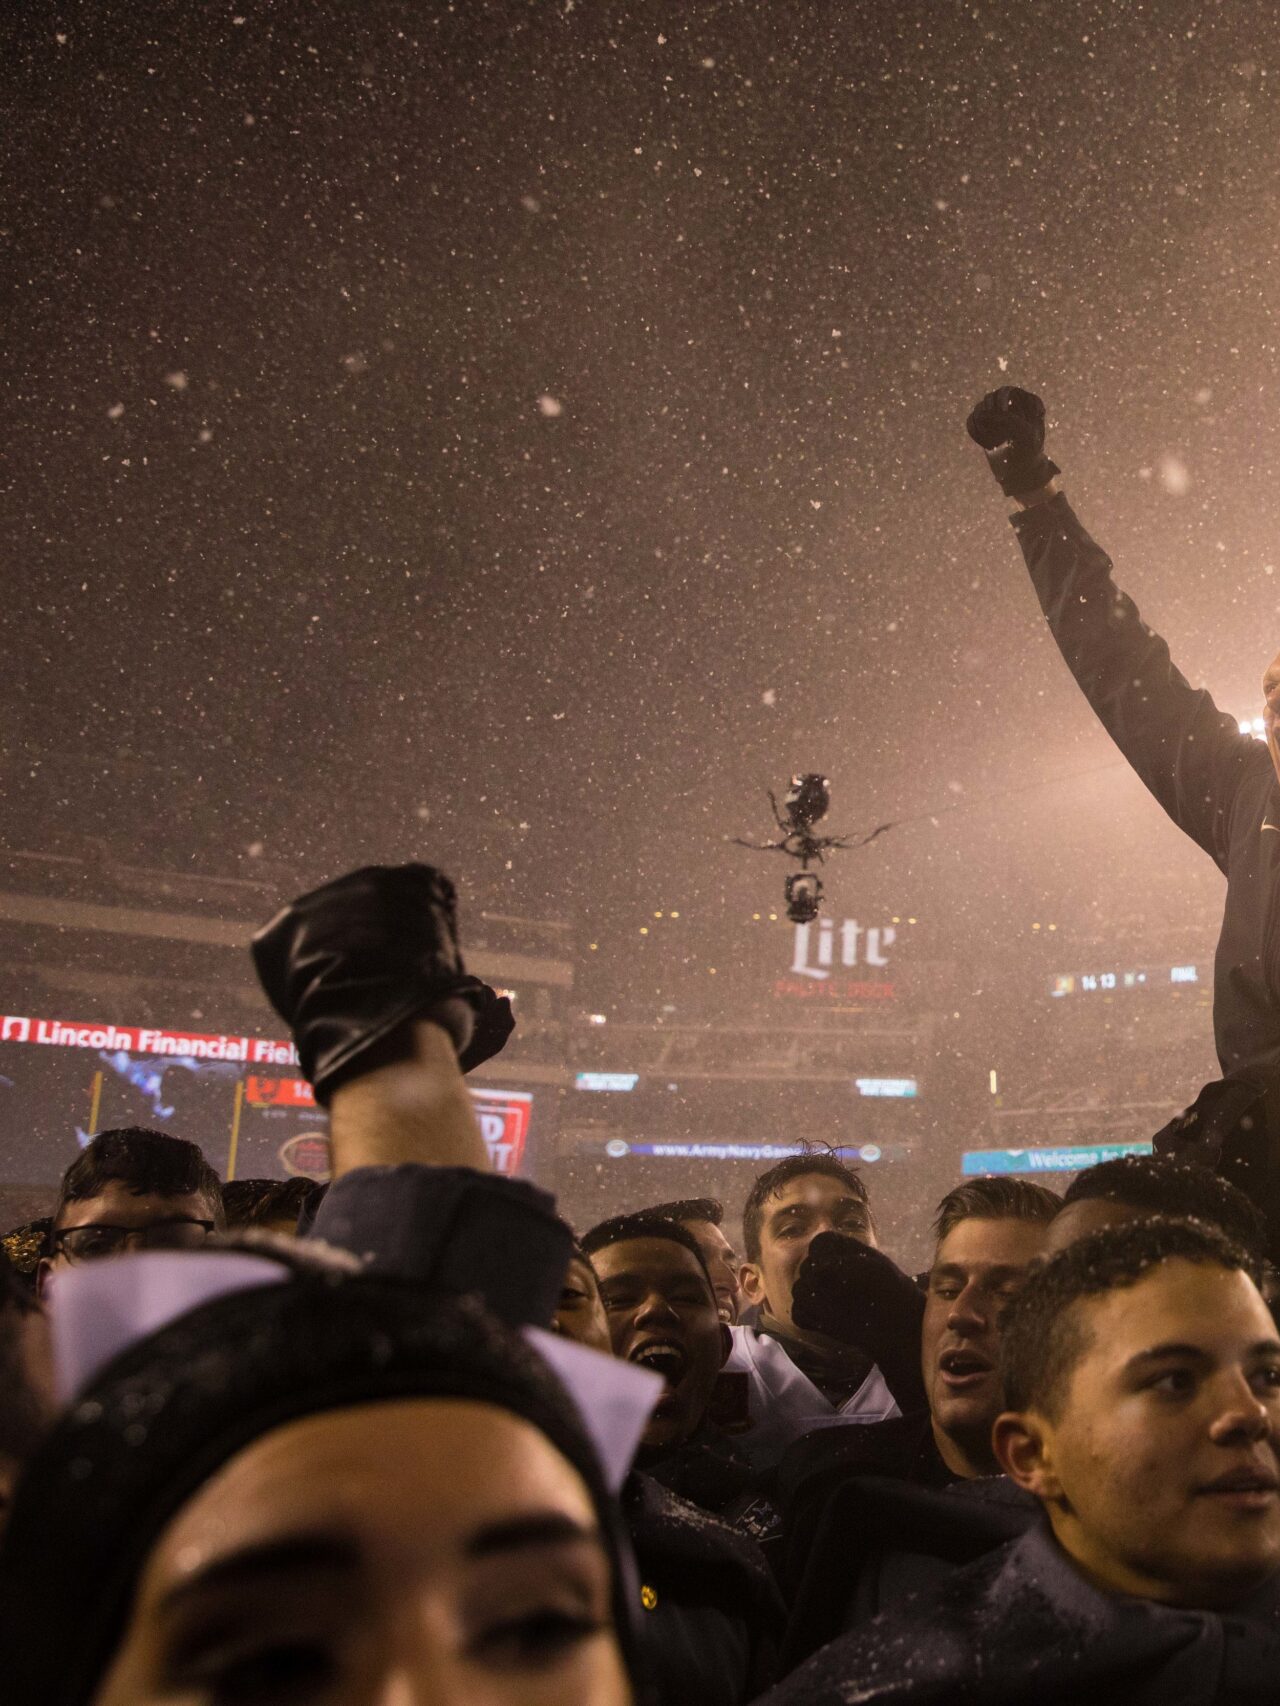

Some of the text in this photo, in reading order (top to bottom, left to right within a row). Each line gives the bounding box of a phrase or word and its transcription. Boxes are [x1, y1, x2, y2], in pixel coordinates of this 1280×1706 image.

[790, 918, 897, 980] Lite
[36, 1020, 300, 1066] Lincoln Financial Fiel
[1027, 1150, 1098, 1169] Welcome
